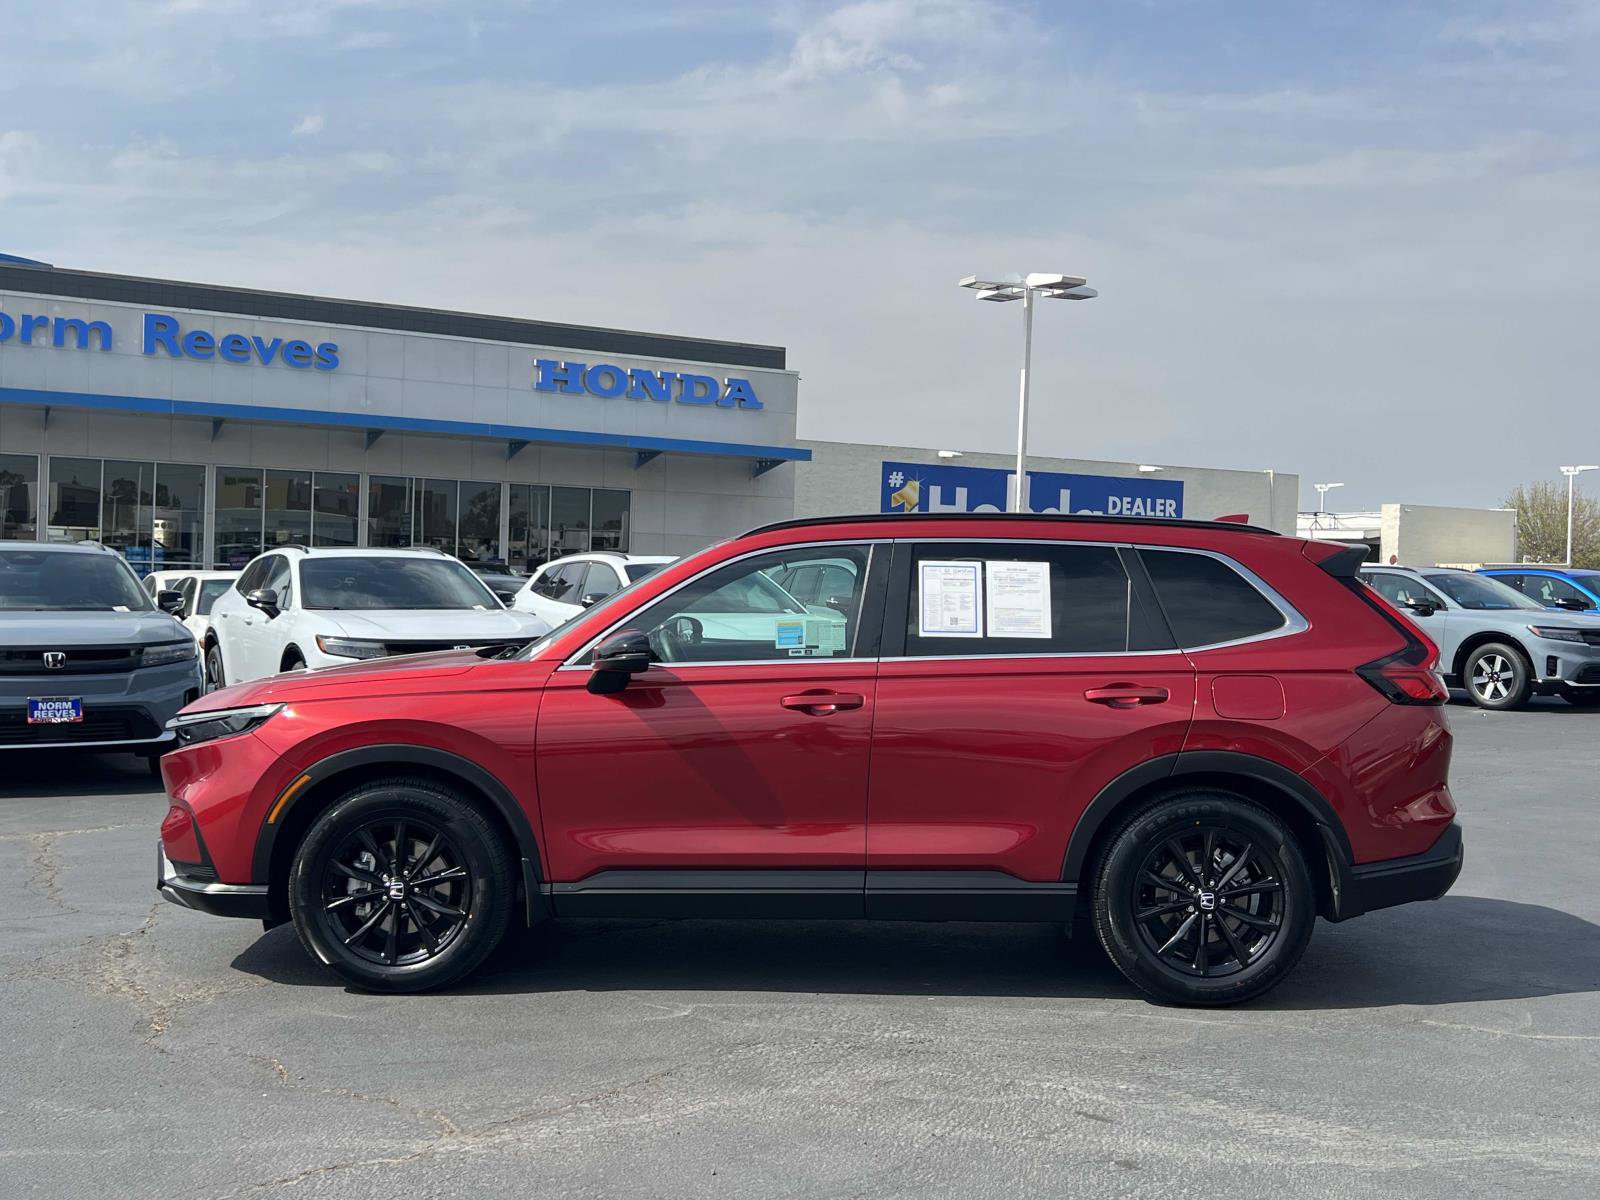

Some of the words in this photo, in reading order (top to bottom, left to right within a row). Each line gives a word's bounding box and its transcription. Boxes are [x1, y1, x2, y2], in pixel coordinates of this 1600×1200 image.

[143, 313, 340, 370] Reeves
[533, 359, 763, 409] HONDA
[1107, 495, 1177, 518] DEALER
[33, 709, 76, 718] REEVES
[38, 702, 73, 710] NORM
